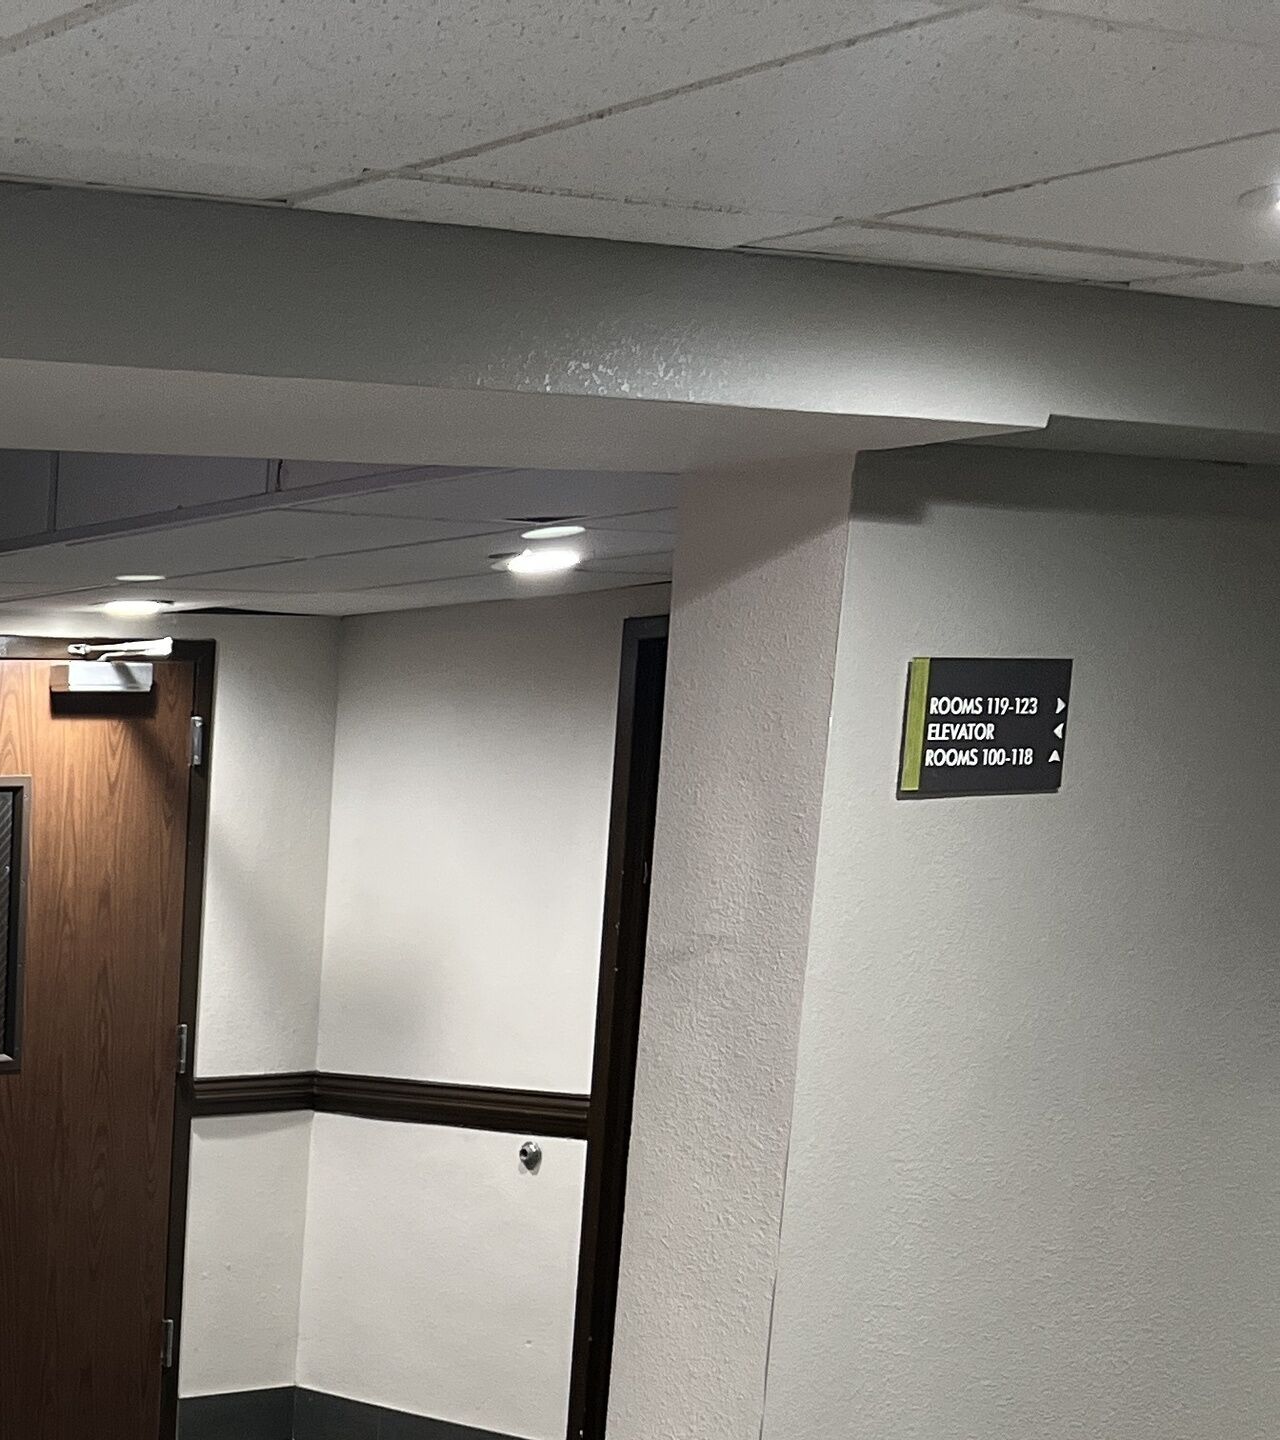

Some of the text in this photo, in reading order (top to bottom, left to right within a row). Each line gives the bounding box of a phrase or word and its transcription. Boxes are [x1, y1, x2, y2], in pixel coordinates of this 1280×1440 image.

[929, 697, 1038, 715] ROOMS 119-123
[926, 723, 995, 741] ELEVATOR
[925, 749, 1033, 767] ROOMS 100-118
